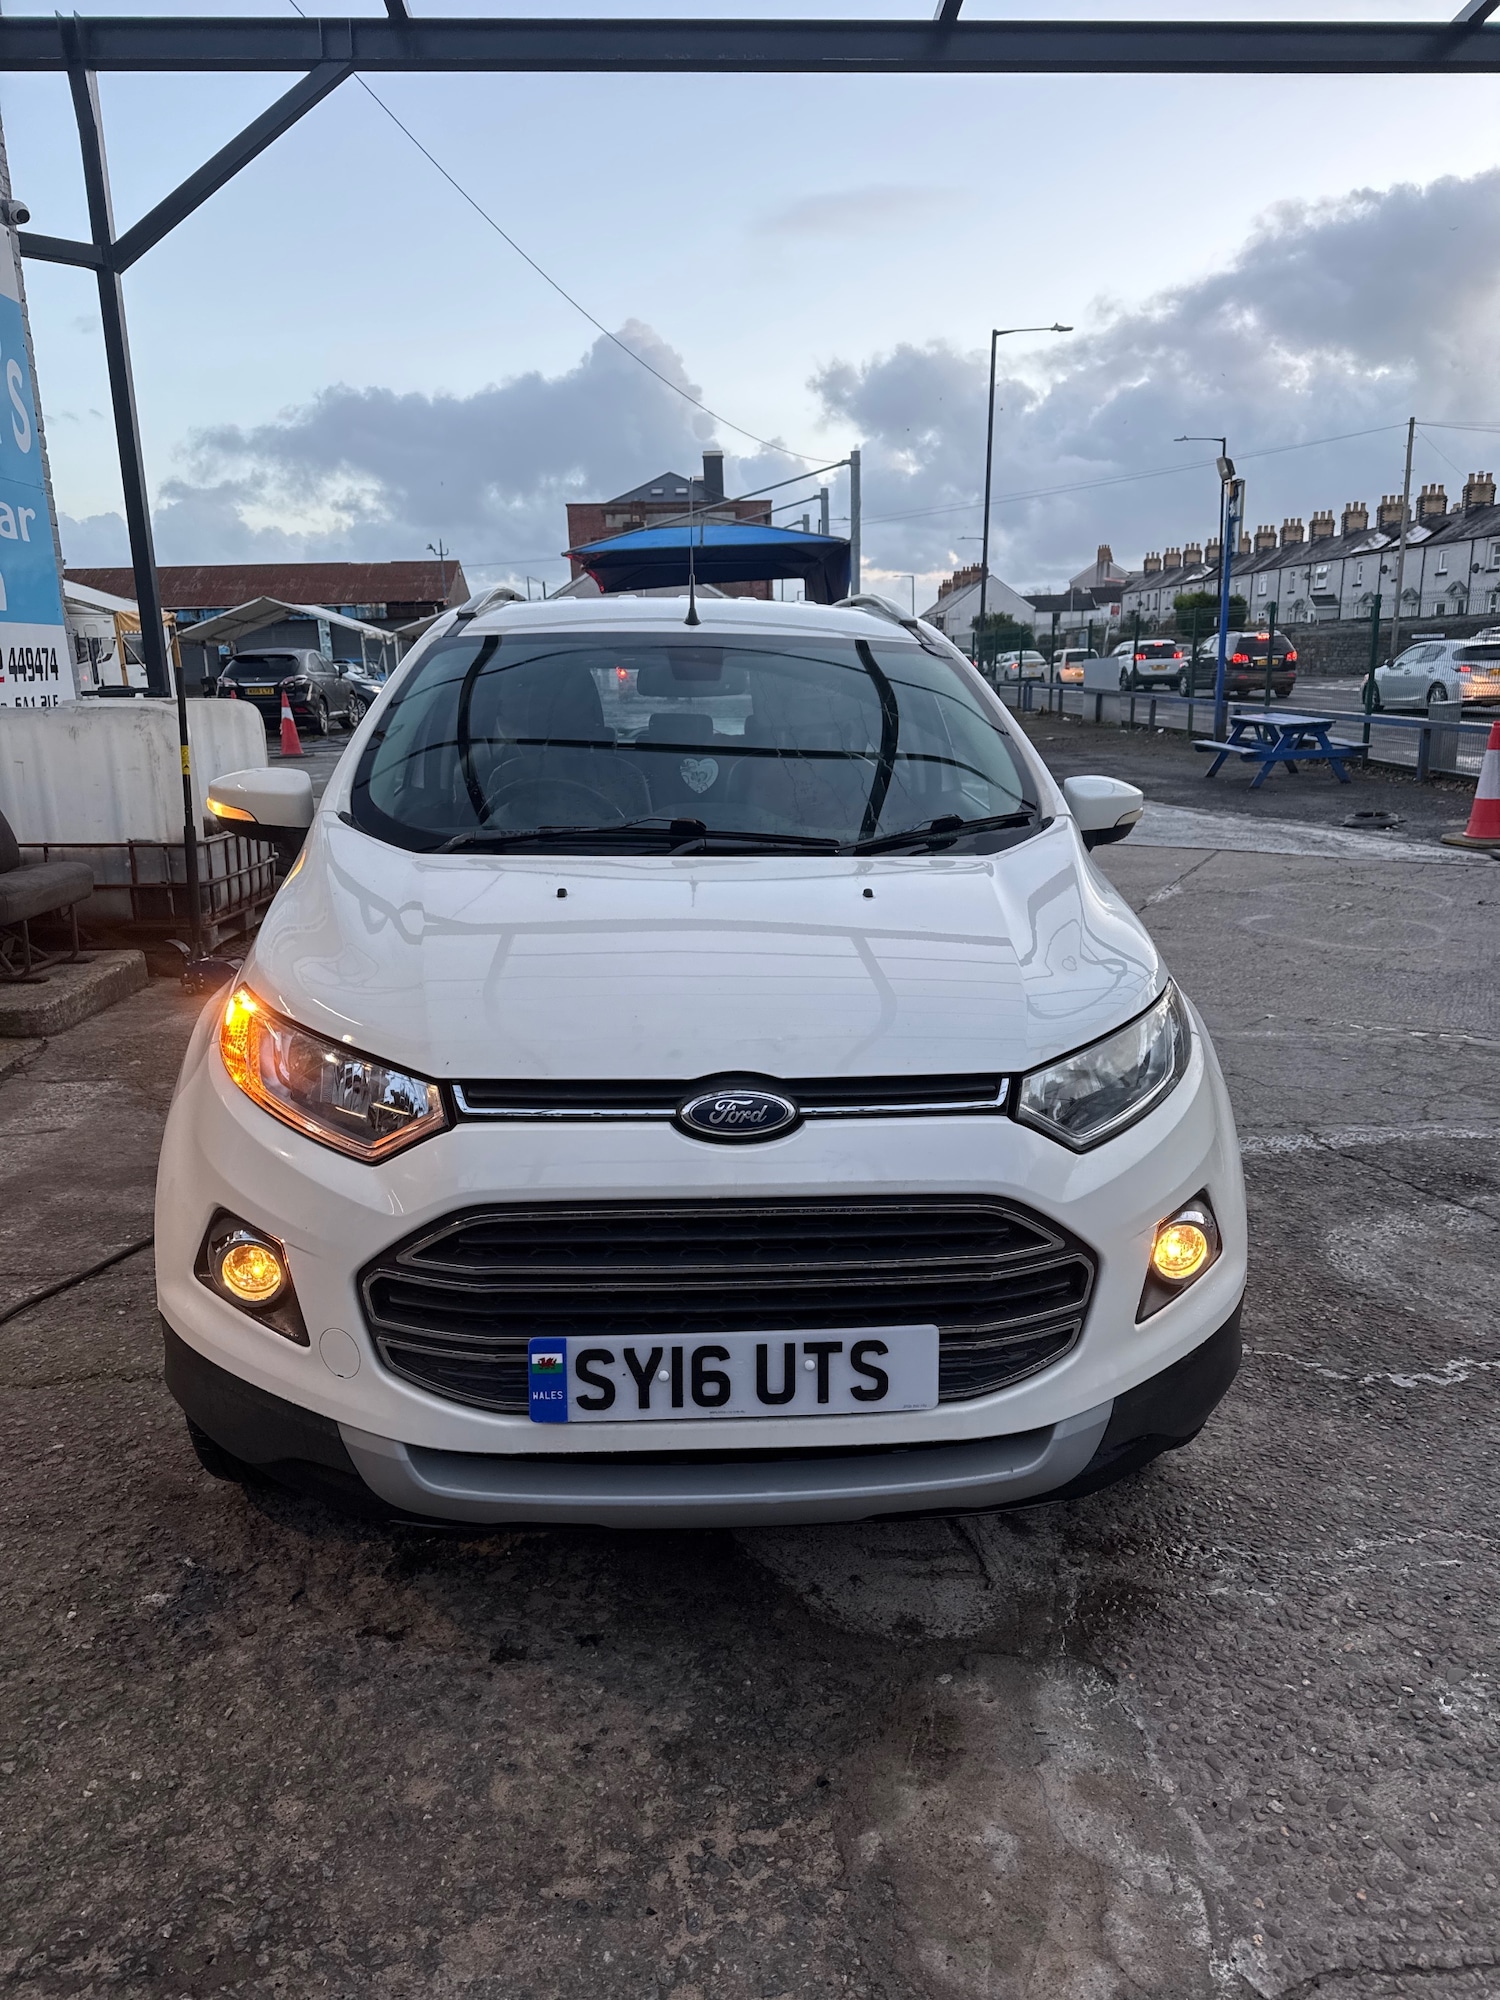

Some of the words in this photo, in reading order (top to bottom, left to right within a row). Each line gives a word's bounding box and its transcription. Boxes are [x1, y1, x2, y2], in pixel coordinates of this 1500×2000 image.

[8, 647, 59, 682] 449474
[709, 1099, 768, 1124] Ford
[575, 1345, 731, 1411] SY16
[756, 1339, 889, 1405] UTS
[532, 1391, 563, 1400] WALES
